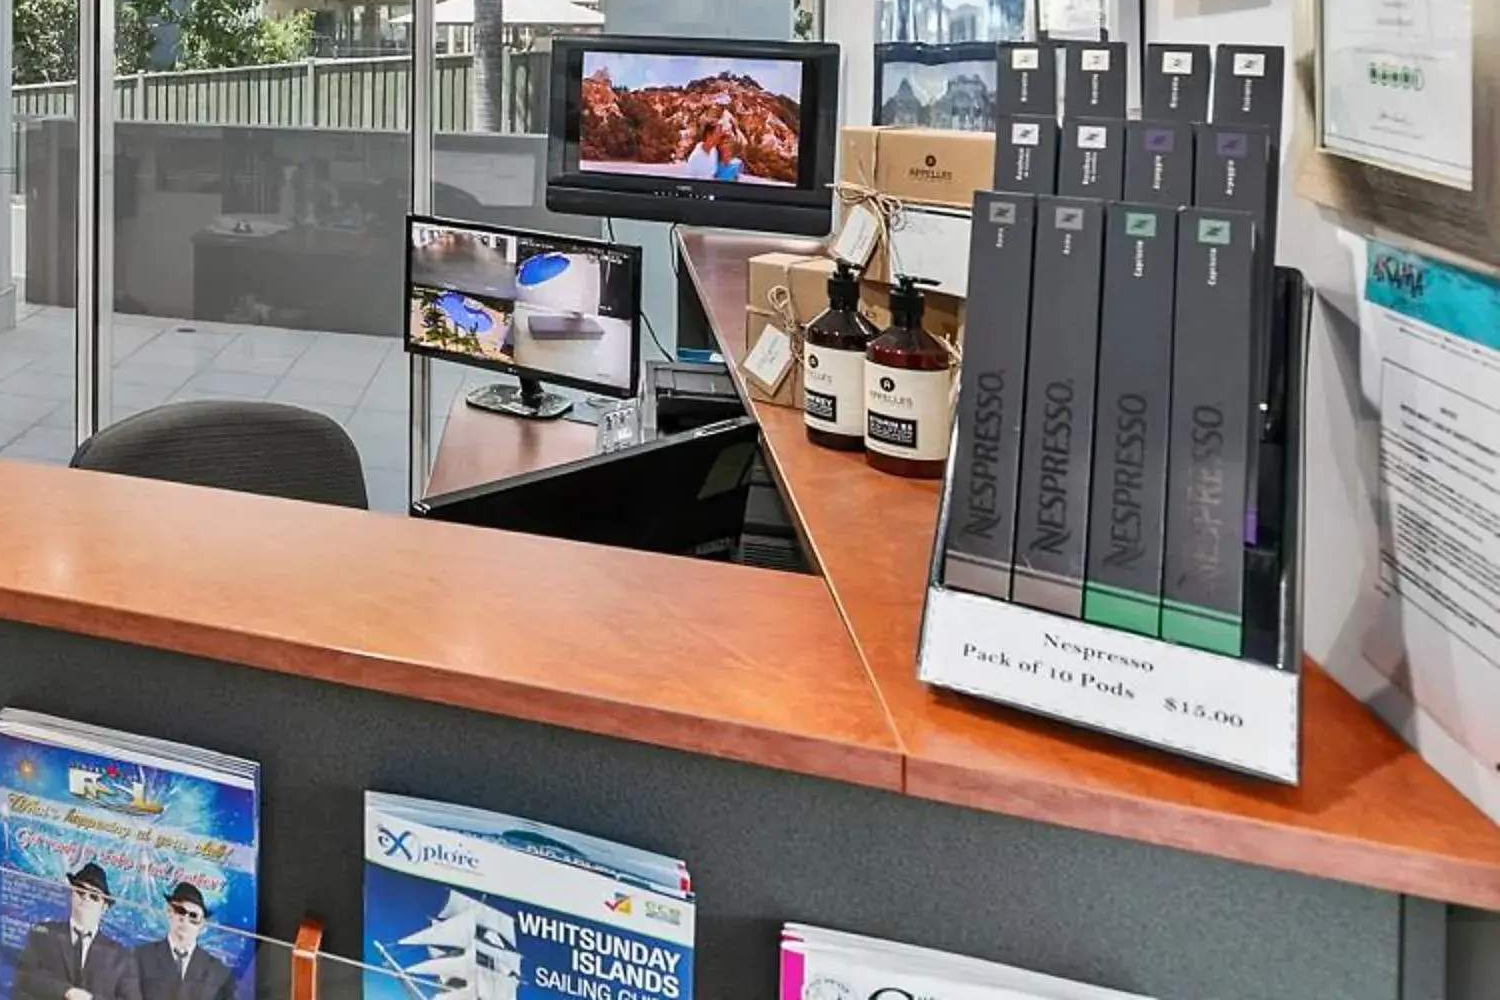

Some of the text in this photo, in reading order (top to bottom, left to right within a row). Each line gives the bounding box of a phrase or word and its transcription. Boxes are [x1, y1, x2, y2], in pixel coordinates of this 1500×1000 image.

[959, 370, 1006, 539] NESPRESSO
[1030, 378, 1075, 554] NESPRESSO
[1103, 392, 1147, 570] NESPRESSO
[963, 643, 1244, 728] Pack of 10 Pods $15.00
[1044, 632, 1155, 672] Nespresso
[518, 911, 681, 974] WHITSUNDAY
[572, 950, 680, 999] ISLANDS
[536, 967, 611, 1000] SAILING
